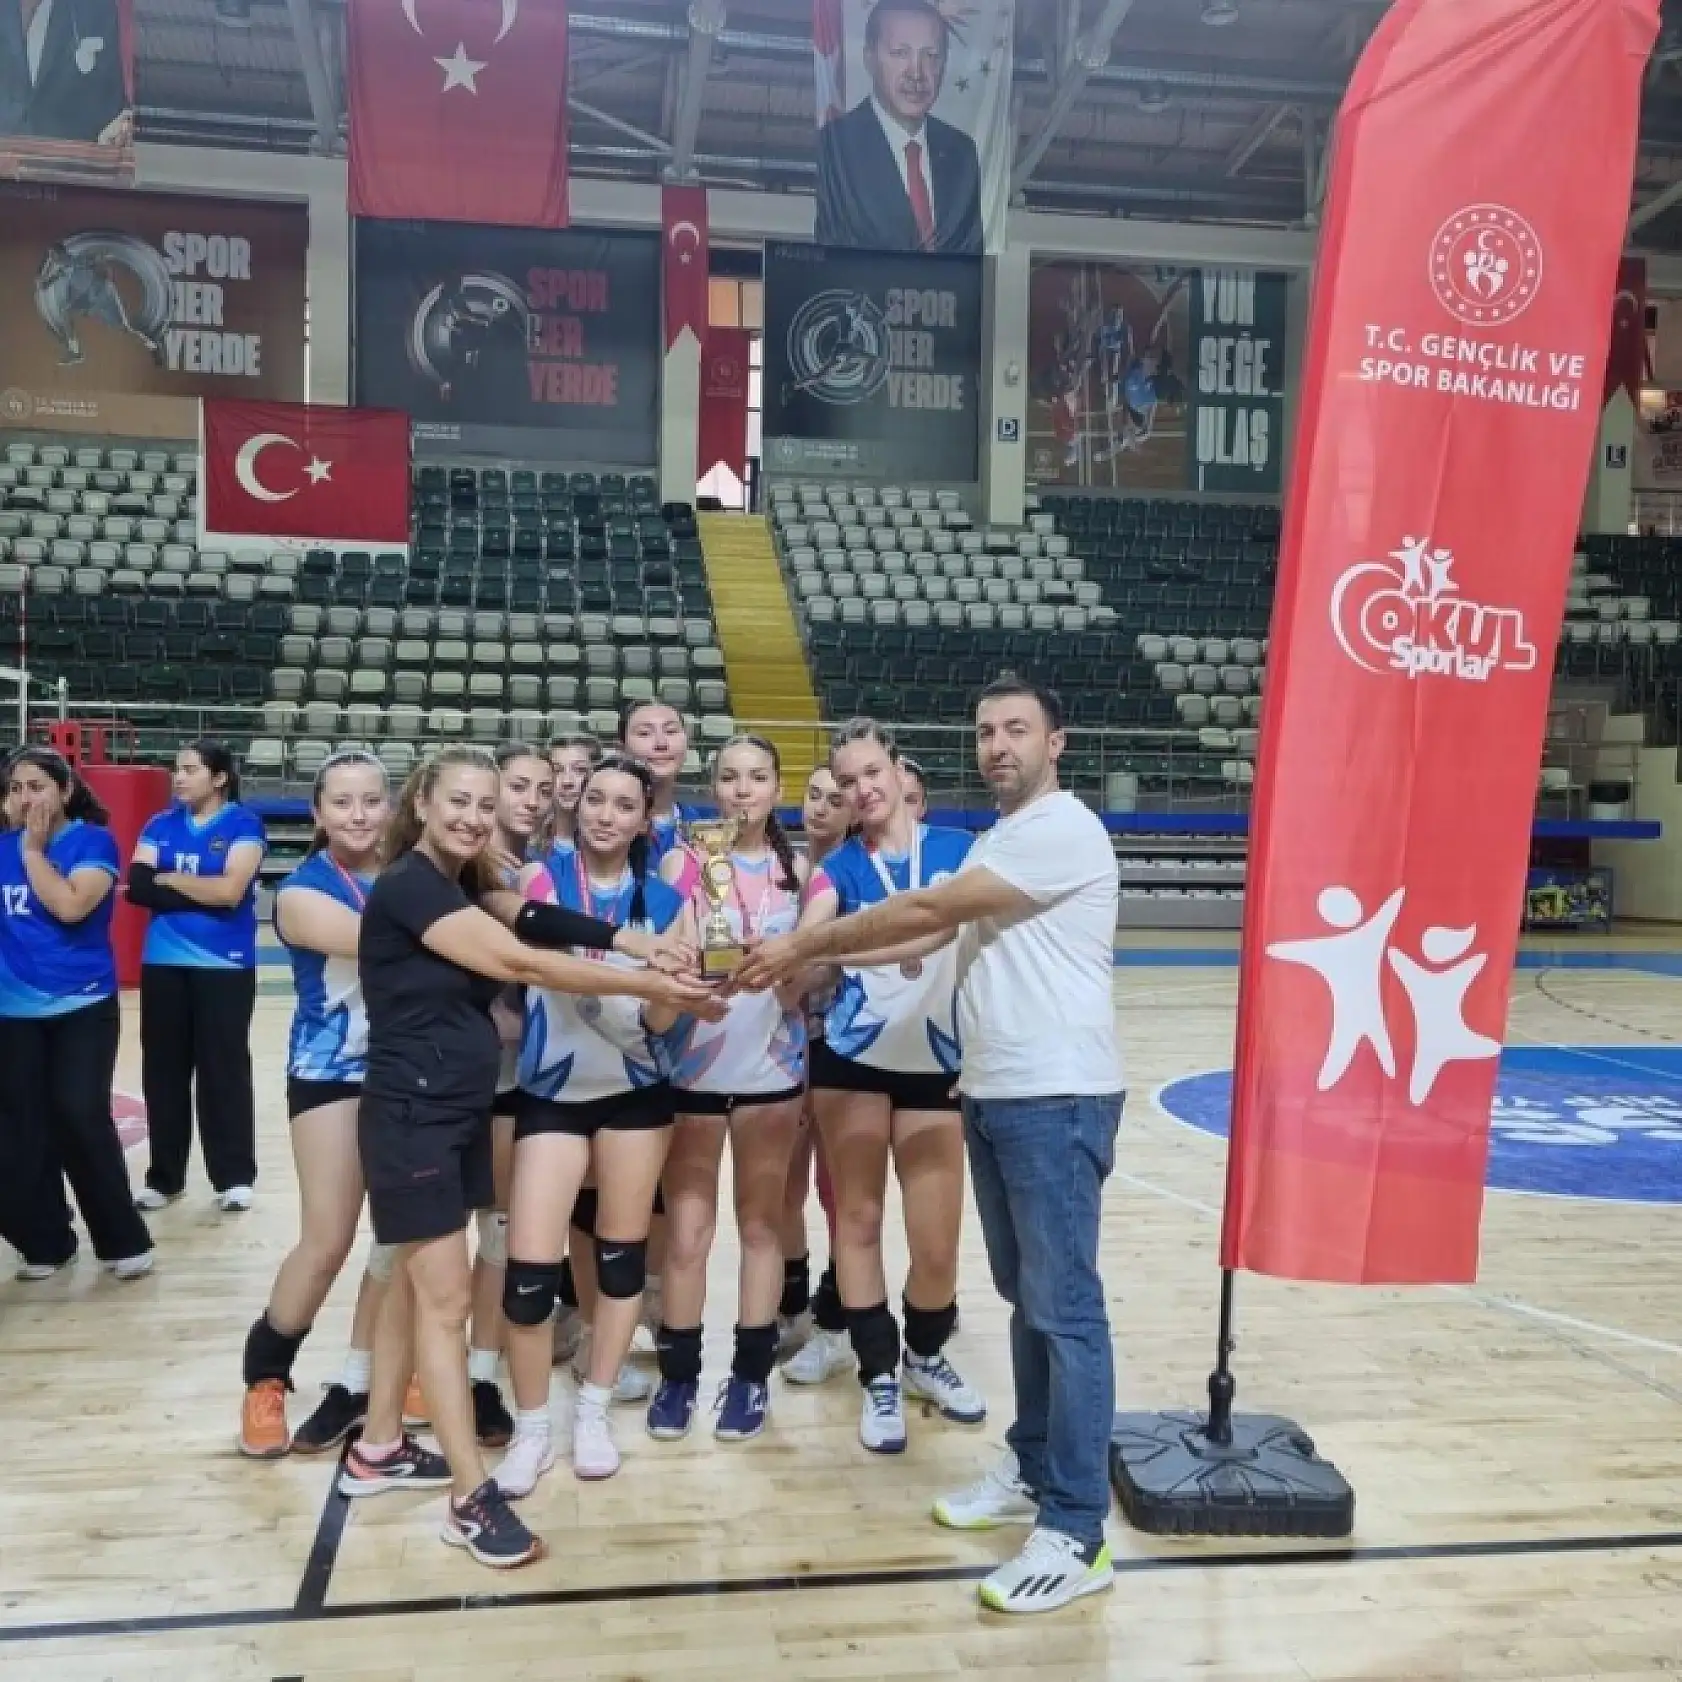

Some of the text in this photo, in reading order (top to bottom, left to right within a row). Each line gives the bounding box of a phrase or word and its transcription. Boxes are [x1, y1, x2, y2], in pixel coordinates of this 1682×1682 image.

[163, 230, 251, 280] SPOR
[527, 267, 608, 312] SPOR
[885, 288, 957, 328] SPOR
[165, 329, 261, 376] YERDE
[1364, 323, 1585, 379] T.C. GENÇLİK VE
[527, 361, 619, 407] YERDE
[888, 371, 965, 411] YERDE
[1359, 357, 1580, 411] SPOR BAKANLIĞI
[1360, 588, 1538, 670] OKUL
[2, 884, 30, 916] 12
